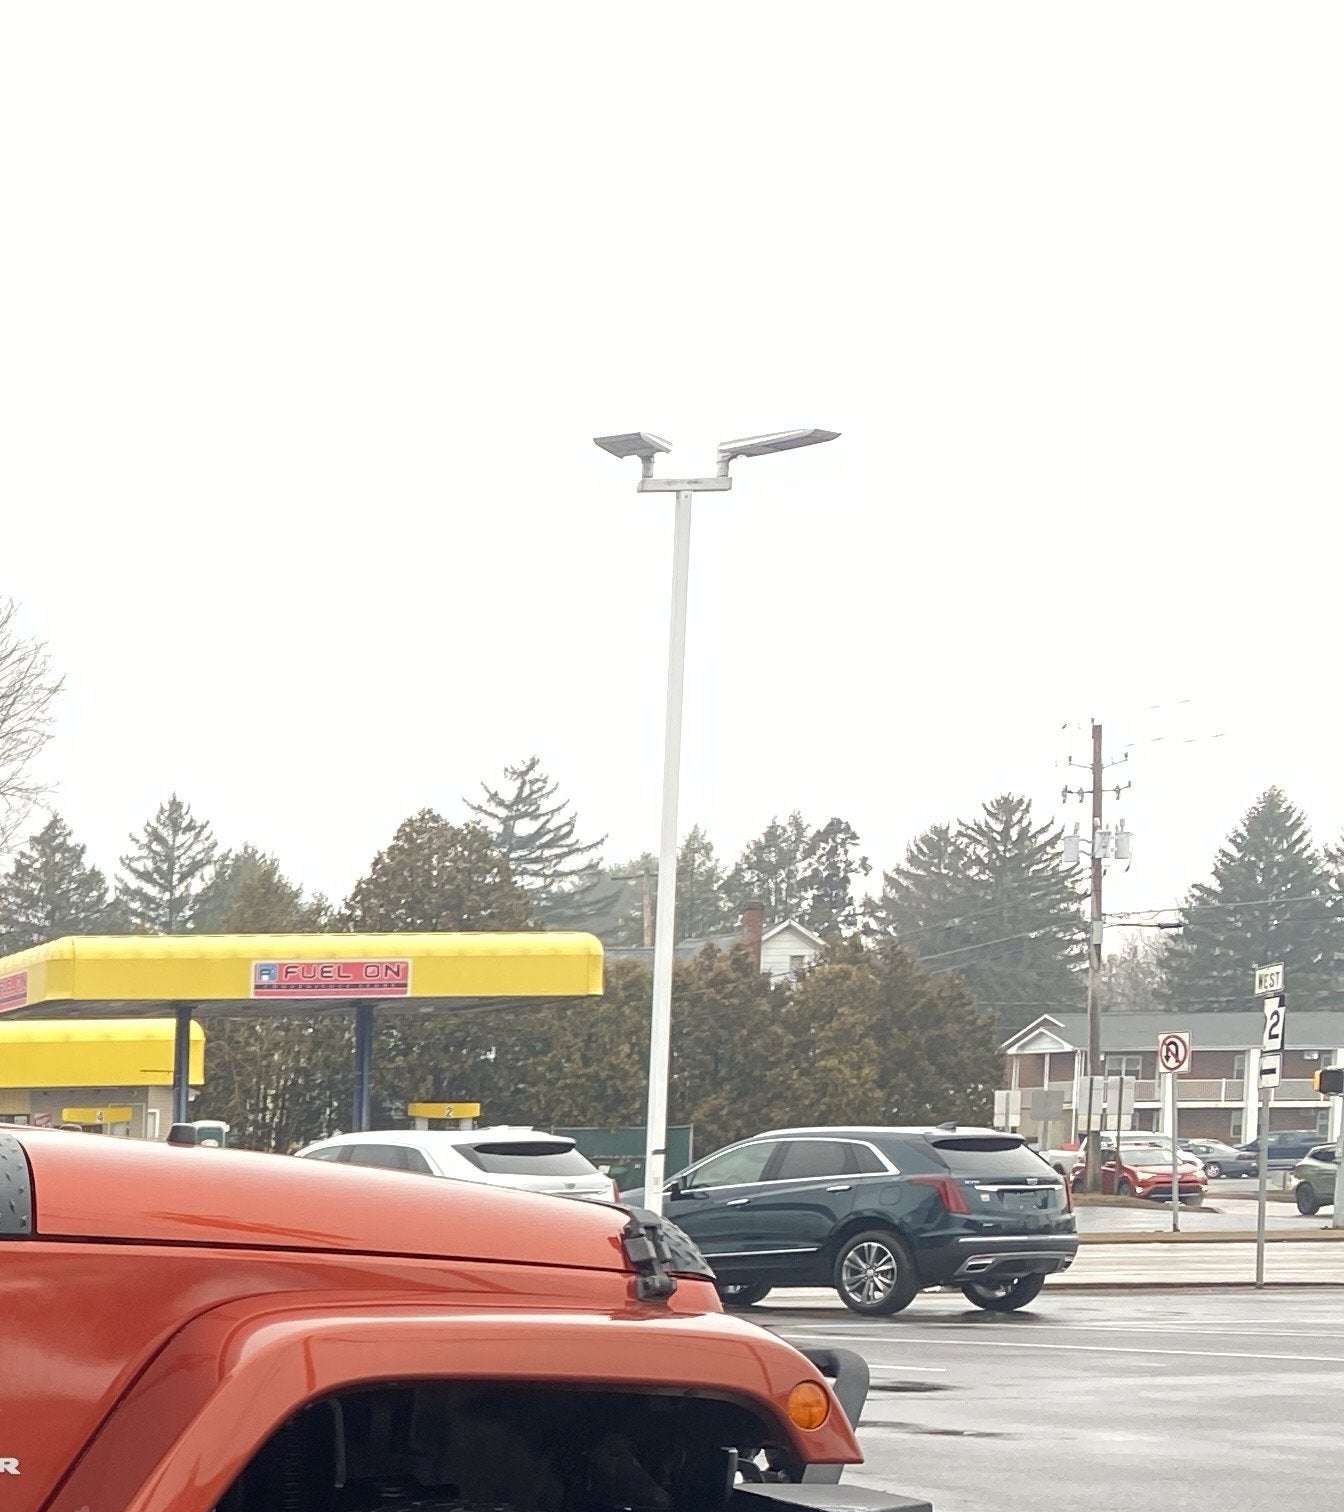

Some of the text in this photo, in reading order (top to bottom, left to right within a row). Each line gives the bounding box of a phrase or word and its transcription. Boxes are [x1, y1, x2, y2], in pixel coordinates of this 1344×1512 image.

[284, 963, 400, 979] FUEL ON
[1258, 972, 1280, 989] WEST
